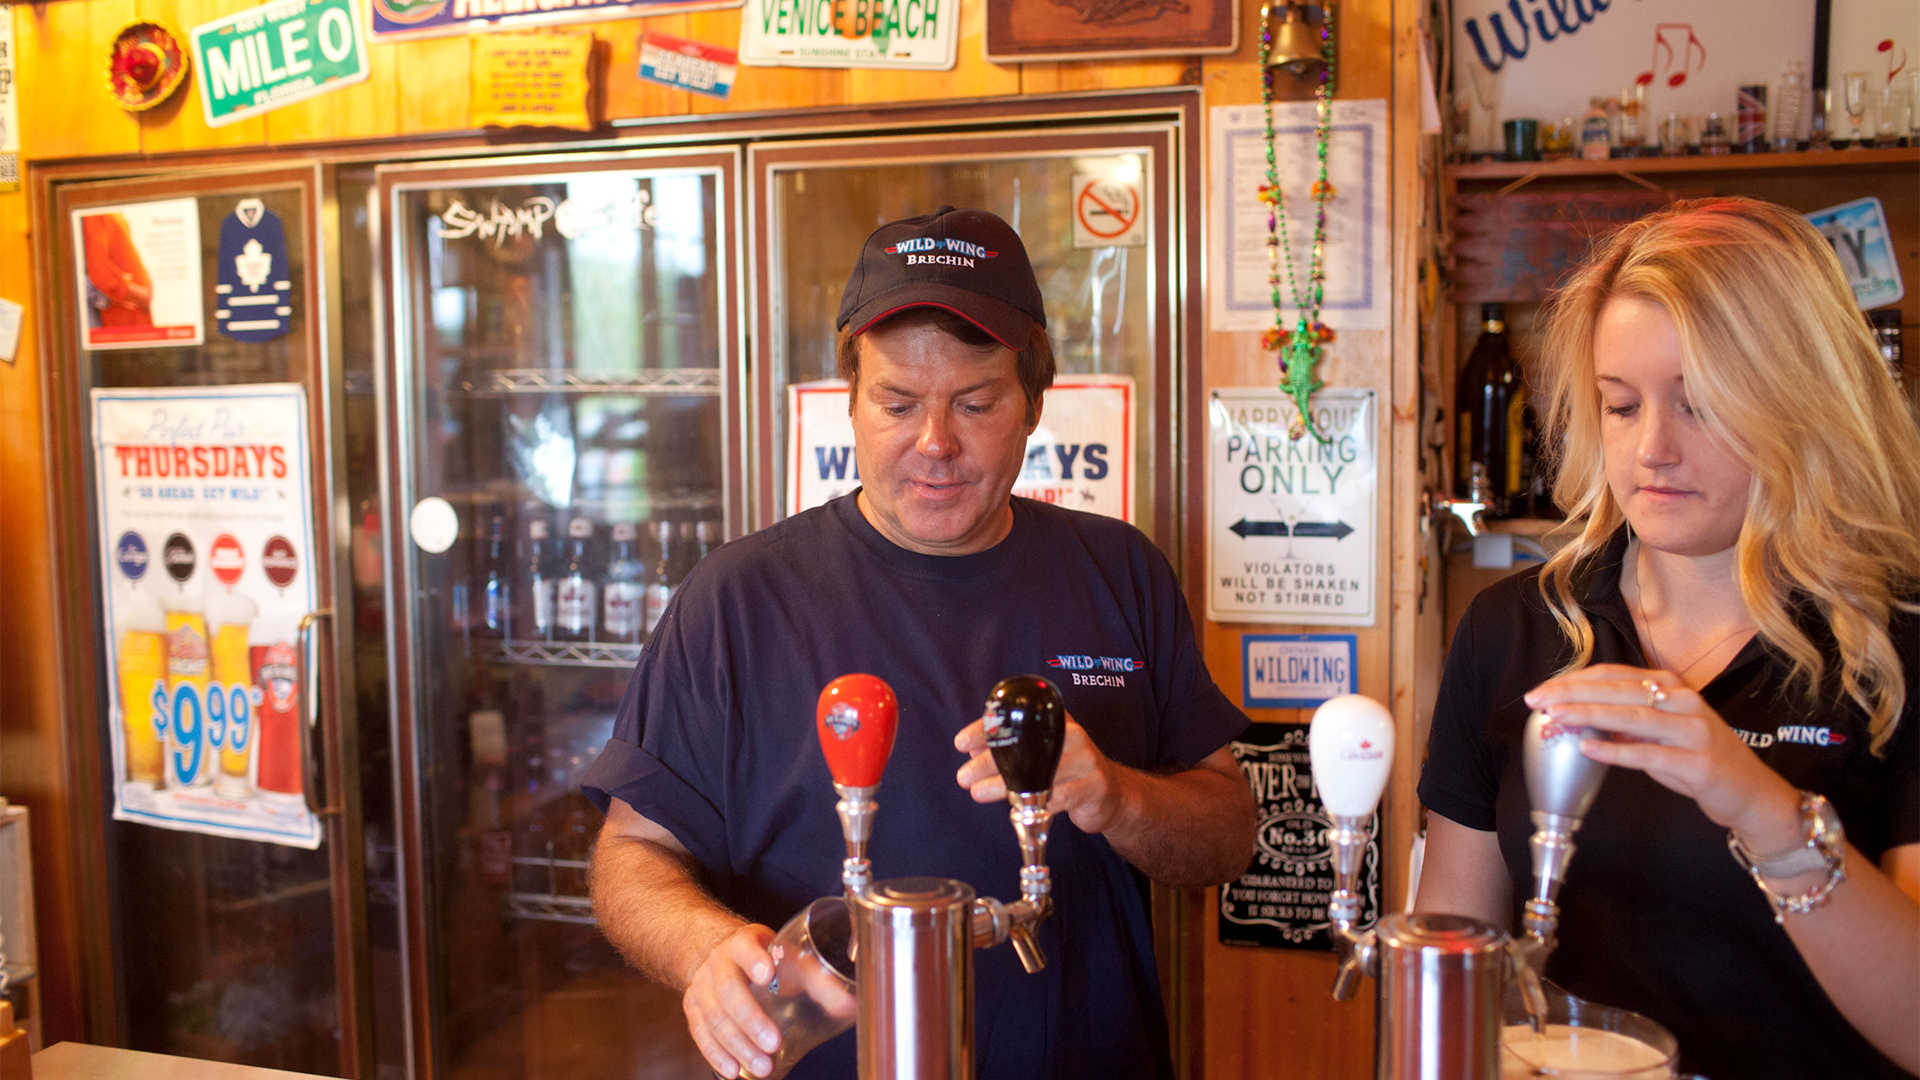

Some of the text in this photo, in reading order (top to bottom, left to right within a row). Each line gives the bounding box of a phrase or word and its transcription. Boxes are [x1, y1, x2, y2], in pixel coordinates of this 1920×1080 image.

[762, 0, 938, 39] VENICE BEACH
[206, 19, 313, 100] MILE
[799, 48, 850, 56] SUNSHINE
[253, 76, 316, 106] FLORIDA
[896, 237, 986, 259] WILD WING
[906, 254, 975, 269] BRECHIN
[1227, 435, 1357, 463] PARKING
[114, 445, 287, 479] THURSDAYS
[1240, 464, 1345, 495] ONLY
[1244, 562, 1336, 575] VIOLATORS
[1220, 577, 1360, 592] WILL BE SHAKEN
[1235, 592, 1345, 606] NOT STIRRED
[1057, 655, 1135, 672] WILD WING
[1254, 657, 1346, 683] WILDWING
[1072, 673, 1126, 688] BRECHIN
[1777, 725, 1831, 747] WING
[1317, 877, 1333, 890] TO
[1295, 906, 1312, 920] TO
